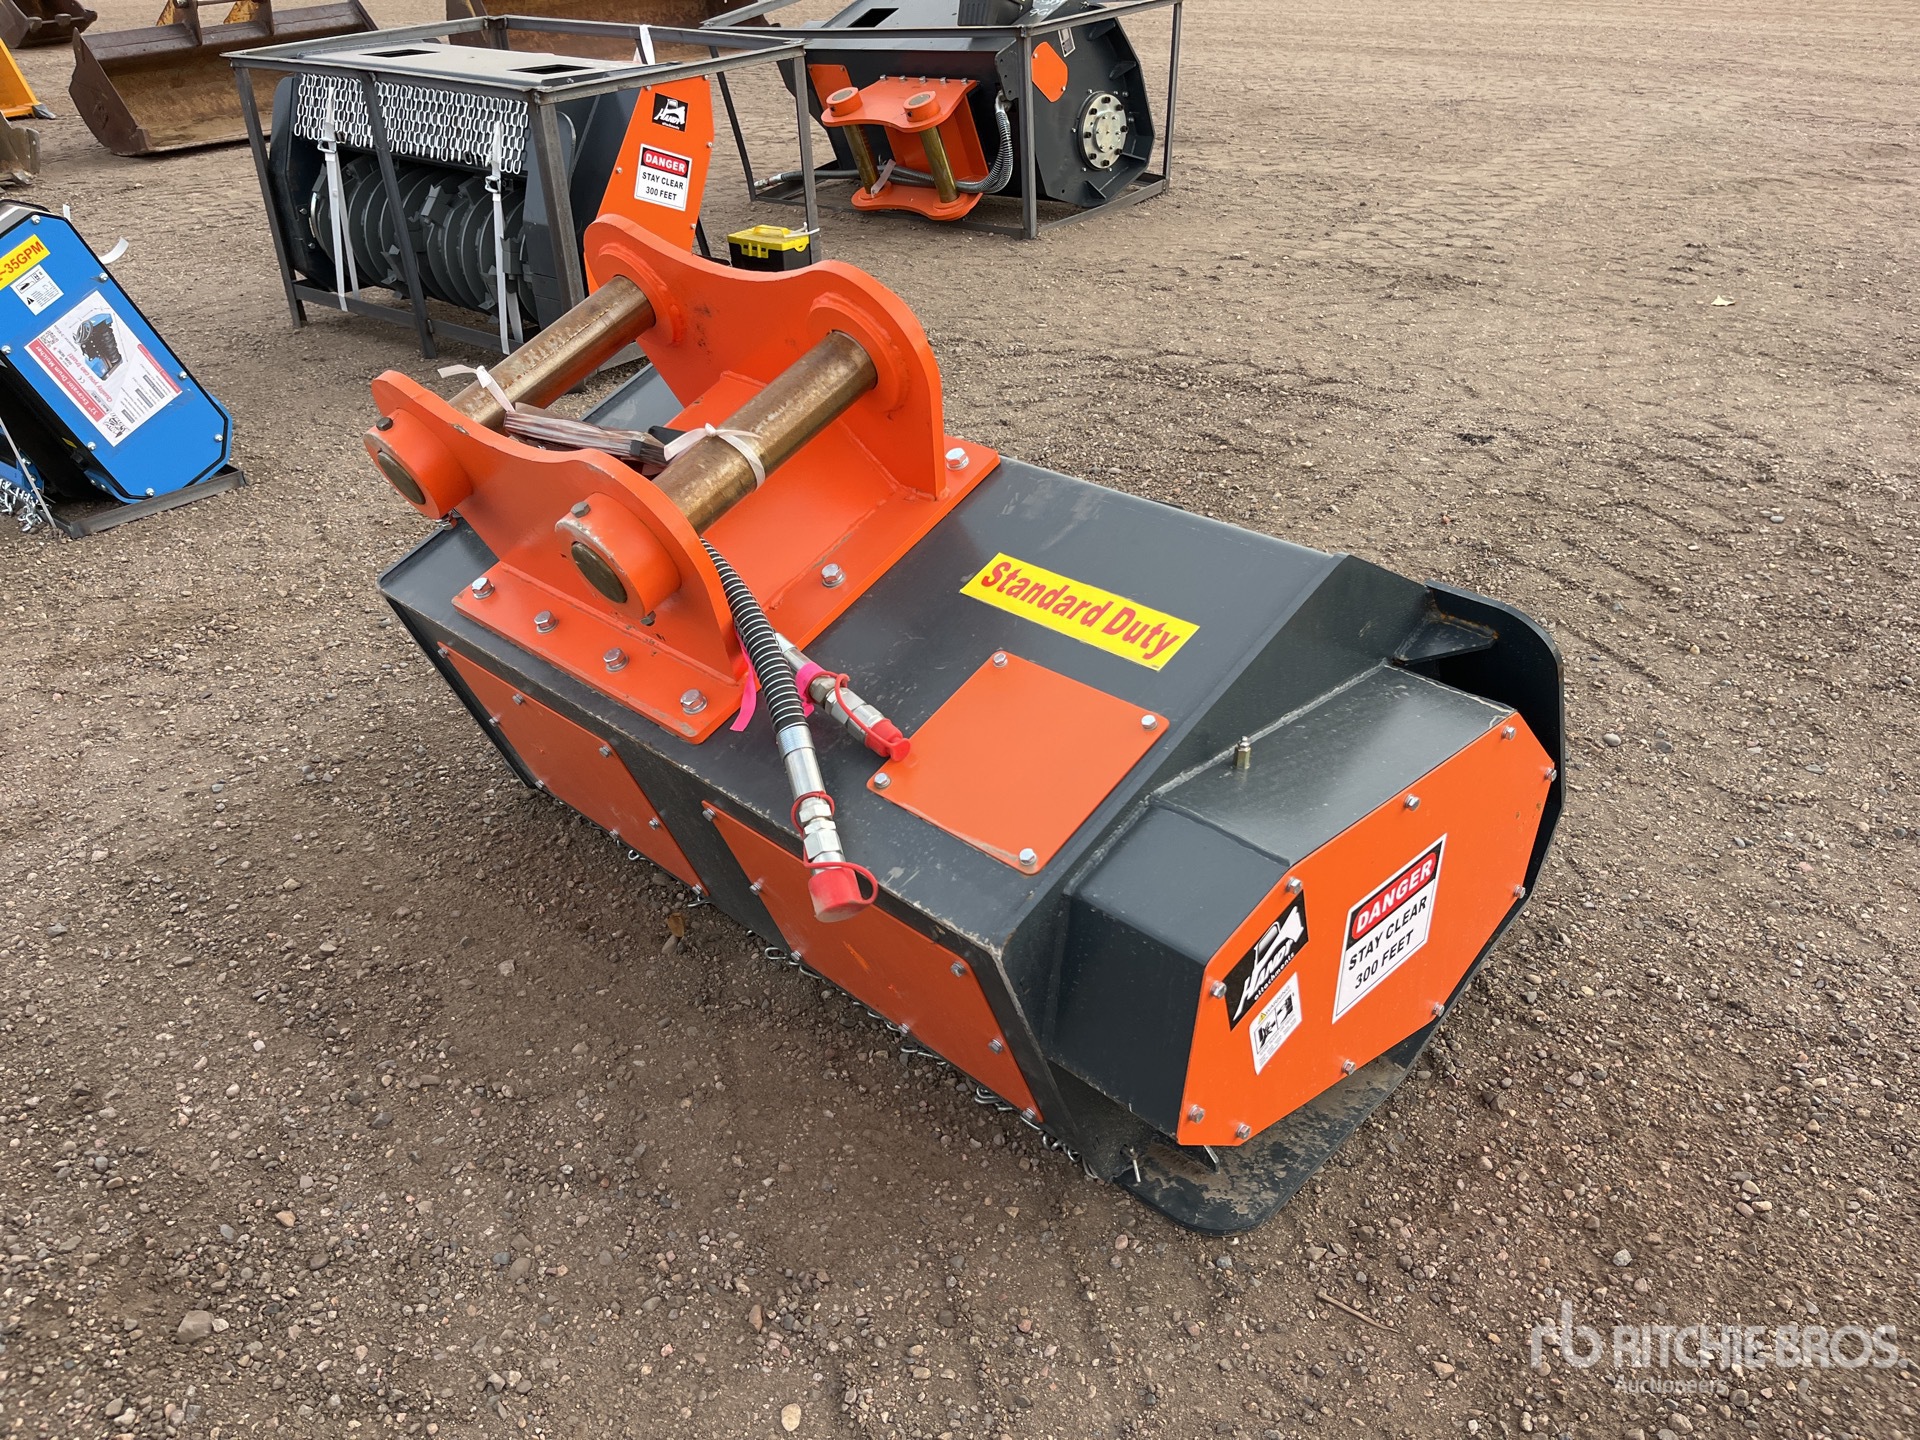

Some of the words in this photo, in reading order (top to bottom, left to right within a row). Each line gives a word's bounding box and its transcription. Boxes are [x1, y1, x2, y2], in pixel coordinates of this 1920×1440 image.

[645, 153, 686, 173] DANGER
[642, 171, 661, 183] STAY
[661, 176, 684, 190] CLEAR
[645, 186, 659, 196] 300
[660, 189, 677, 201] FEET
[52, 365, 68, 382] Drum
[65, 379, 89, 405] Excavator
[95, 383, 113, 403] Quality
[981, 561, 1114, 627] Standard
[1101, 606, 1180, 660] Duty
[1356, 858, 1433, 932] DANGER
[1348, 931, 1384, 971] STAY
[1385, 895, 1427, 938] CLEAR
[1354, 960, 1379, 990] 300
[1381, 929, 1414, 968] FEET
[1253, 952, 1295, 1001] attachments
